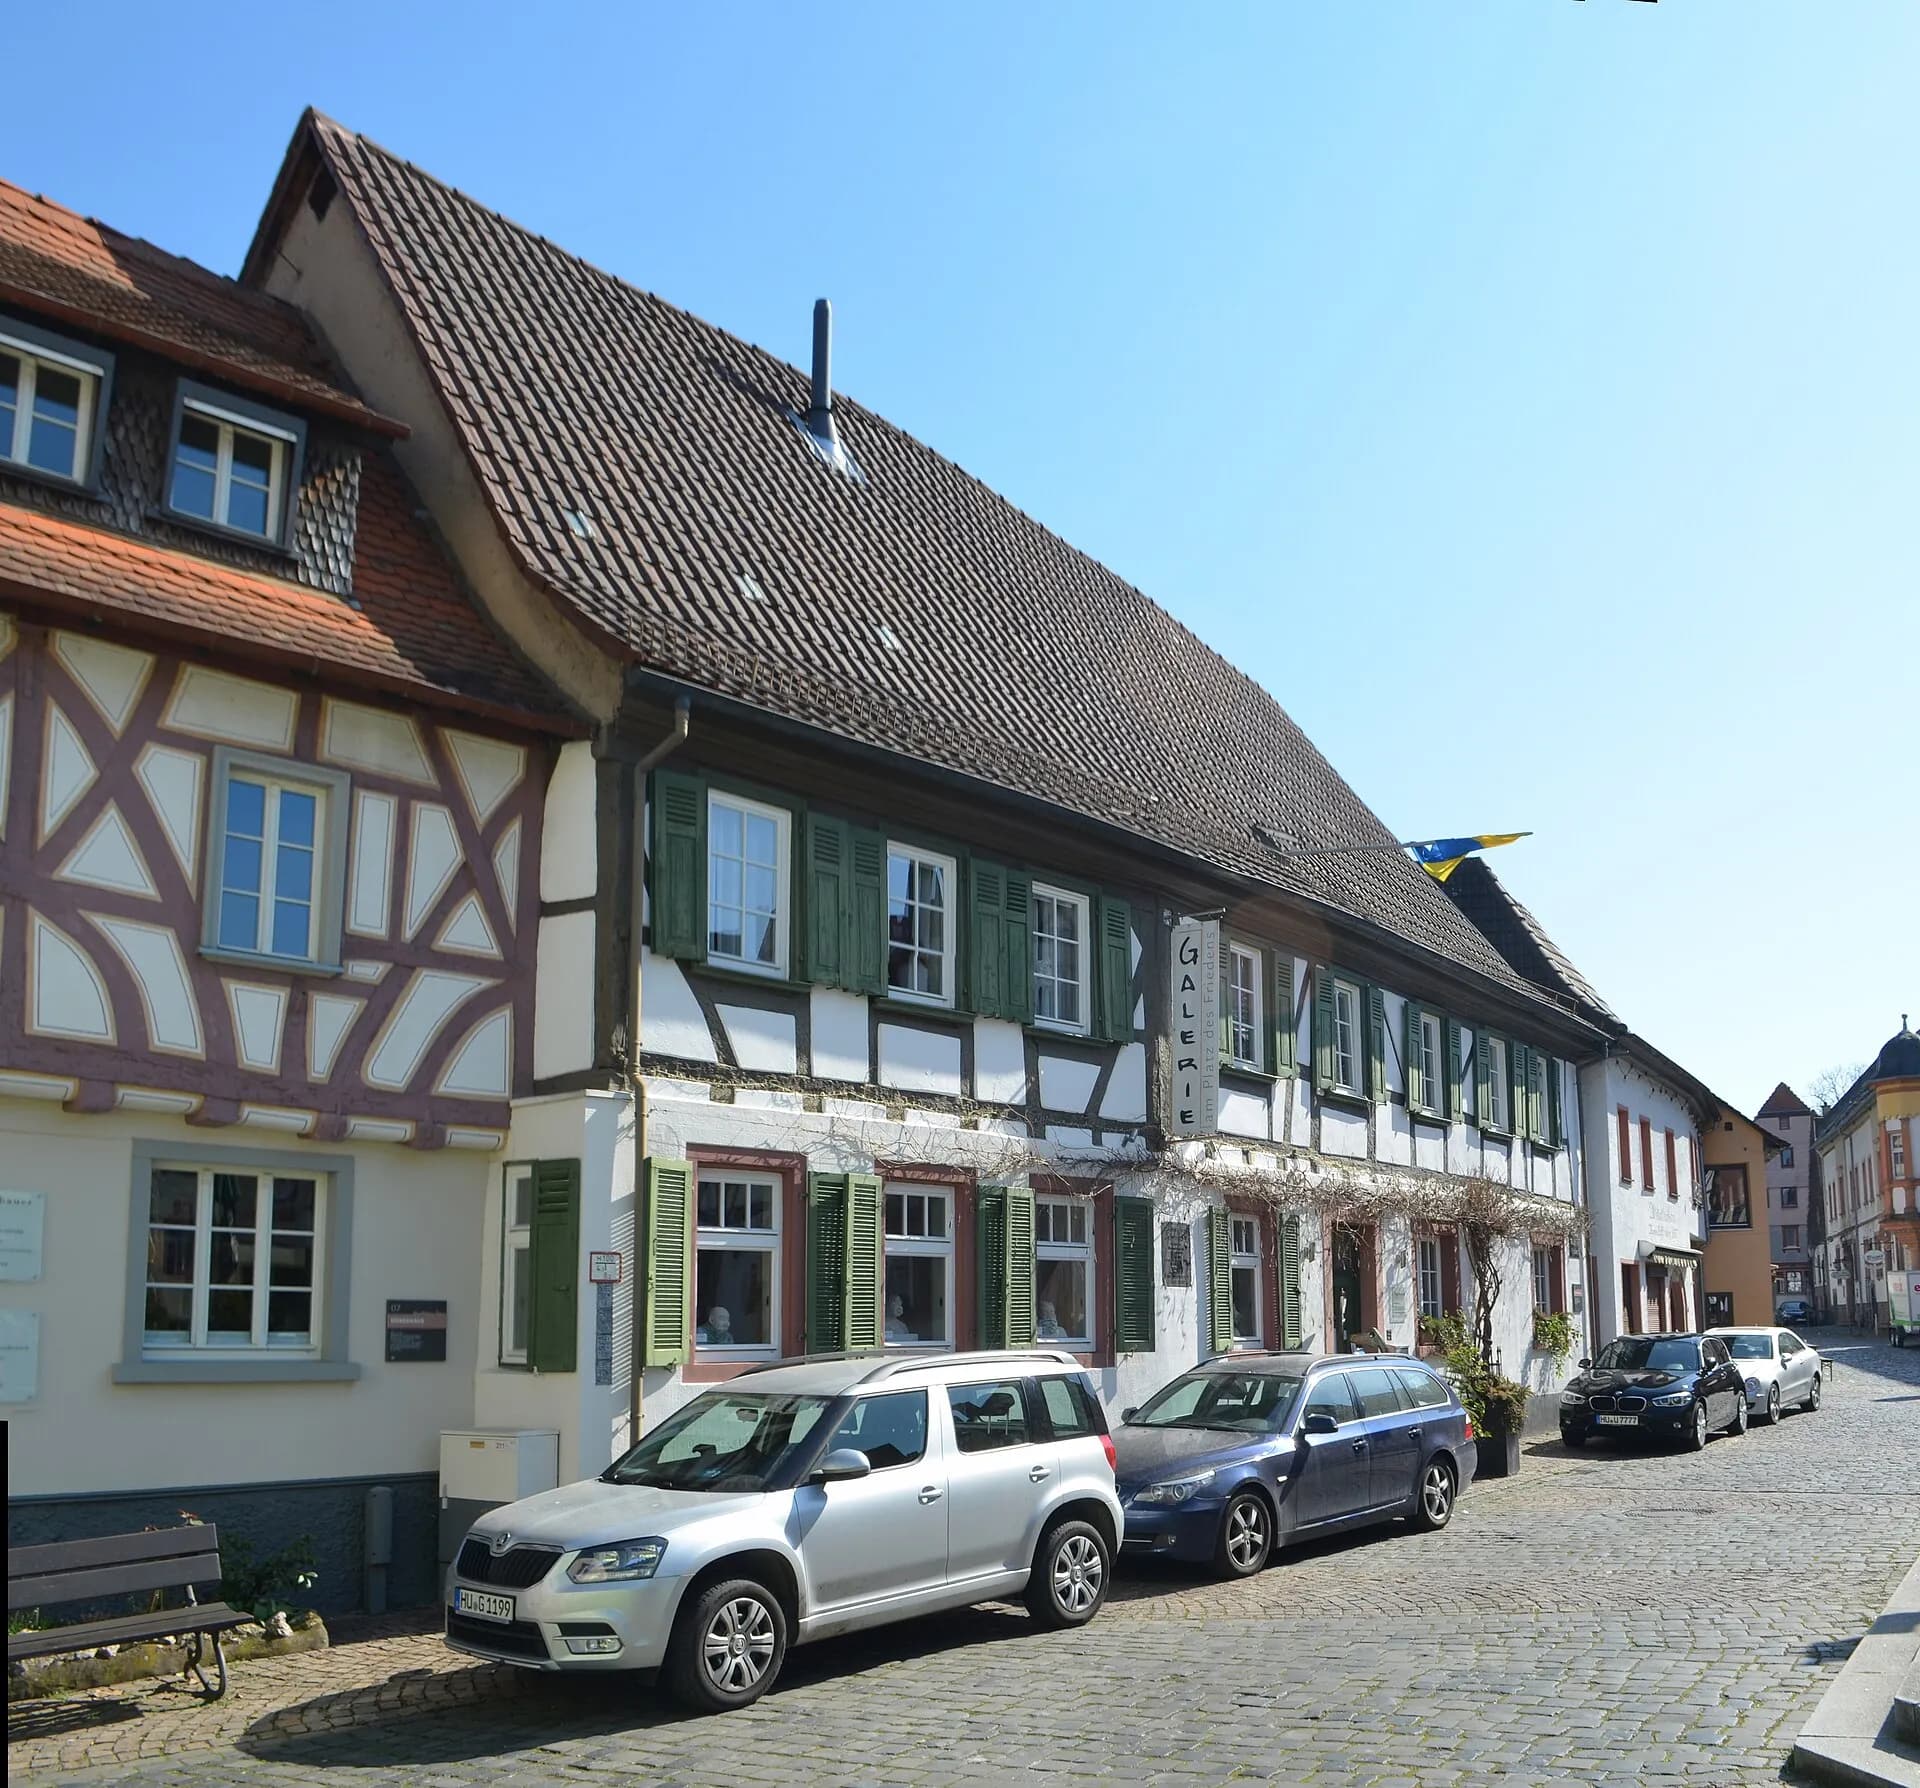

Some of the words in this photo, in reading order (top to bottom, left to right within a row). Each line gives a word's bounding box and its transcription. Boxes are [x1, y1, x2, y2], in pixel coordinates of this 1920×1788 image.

[1203, 932, 1215, 1003] Friedens
[1178, 936, 1198, 1124] GALERIE
[1203, 1011, 1214, 1038] des
[1203, 1047, 1214, 1089] Platz
[1206, 1098, 1214, 1122] am
[461, 1591, 473, 1610] HU
